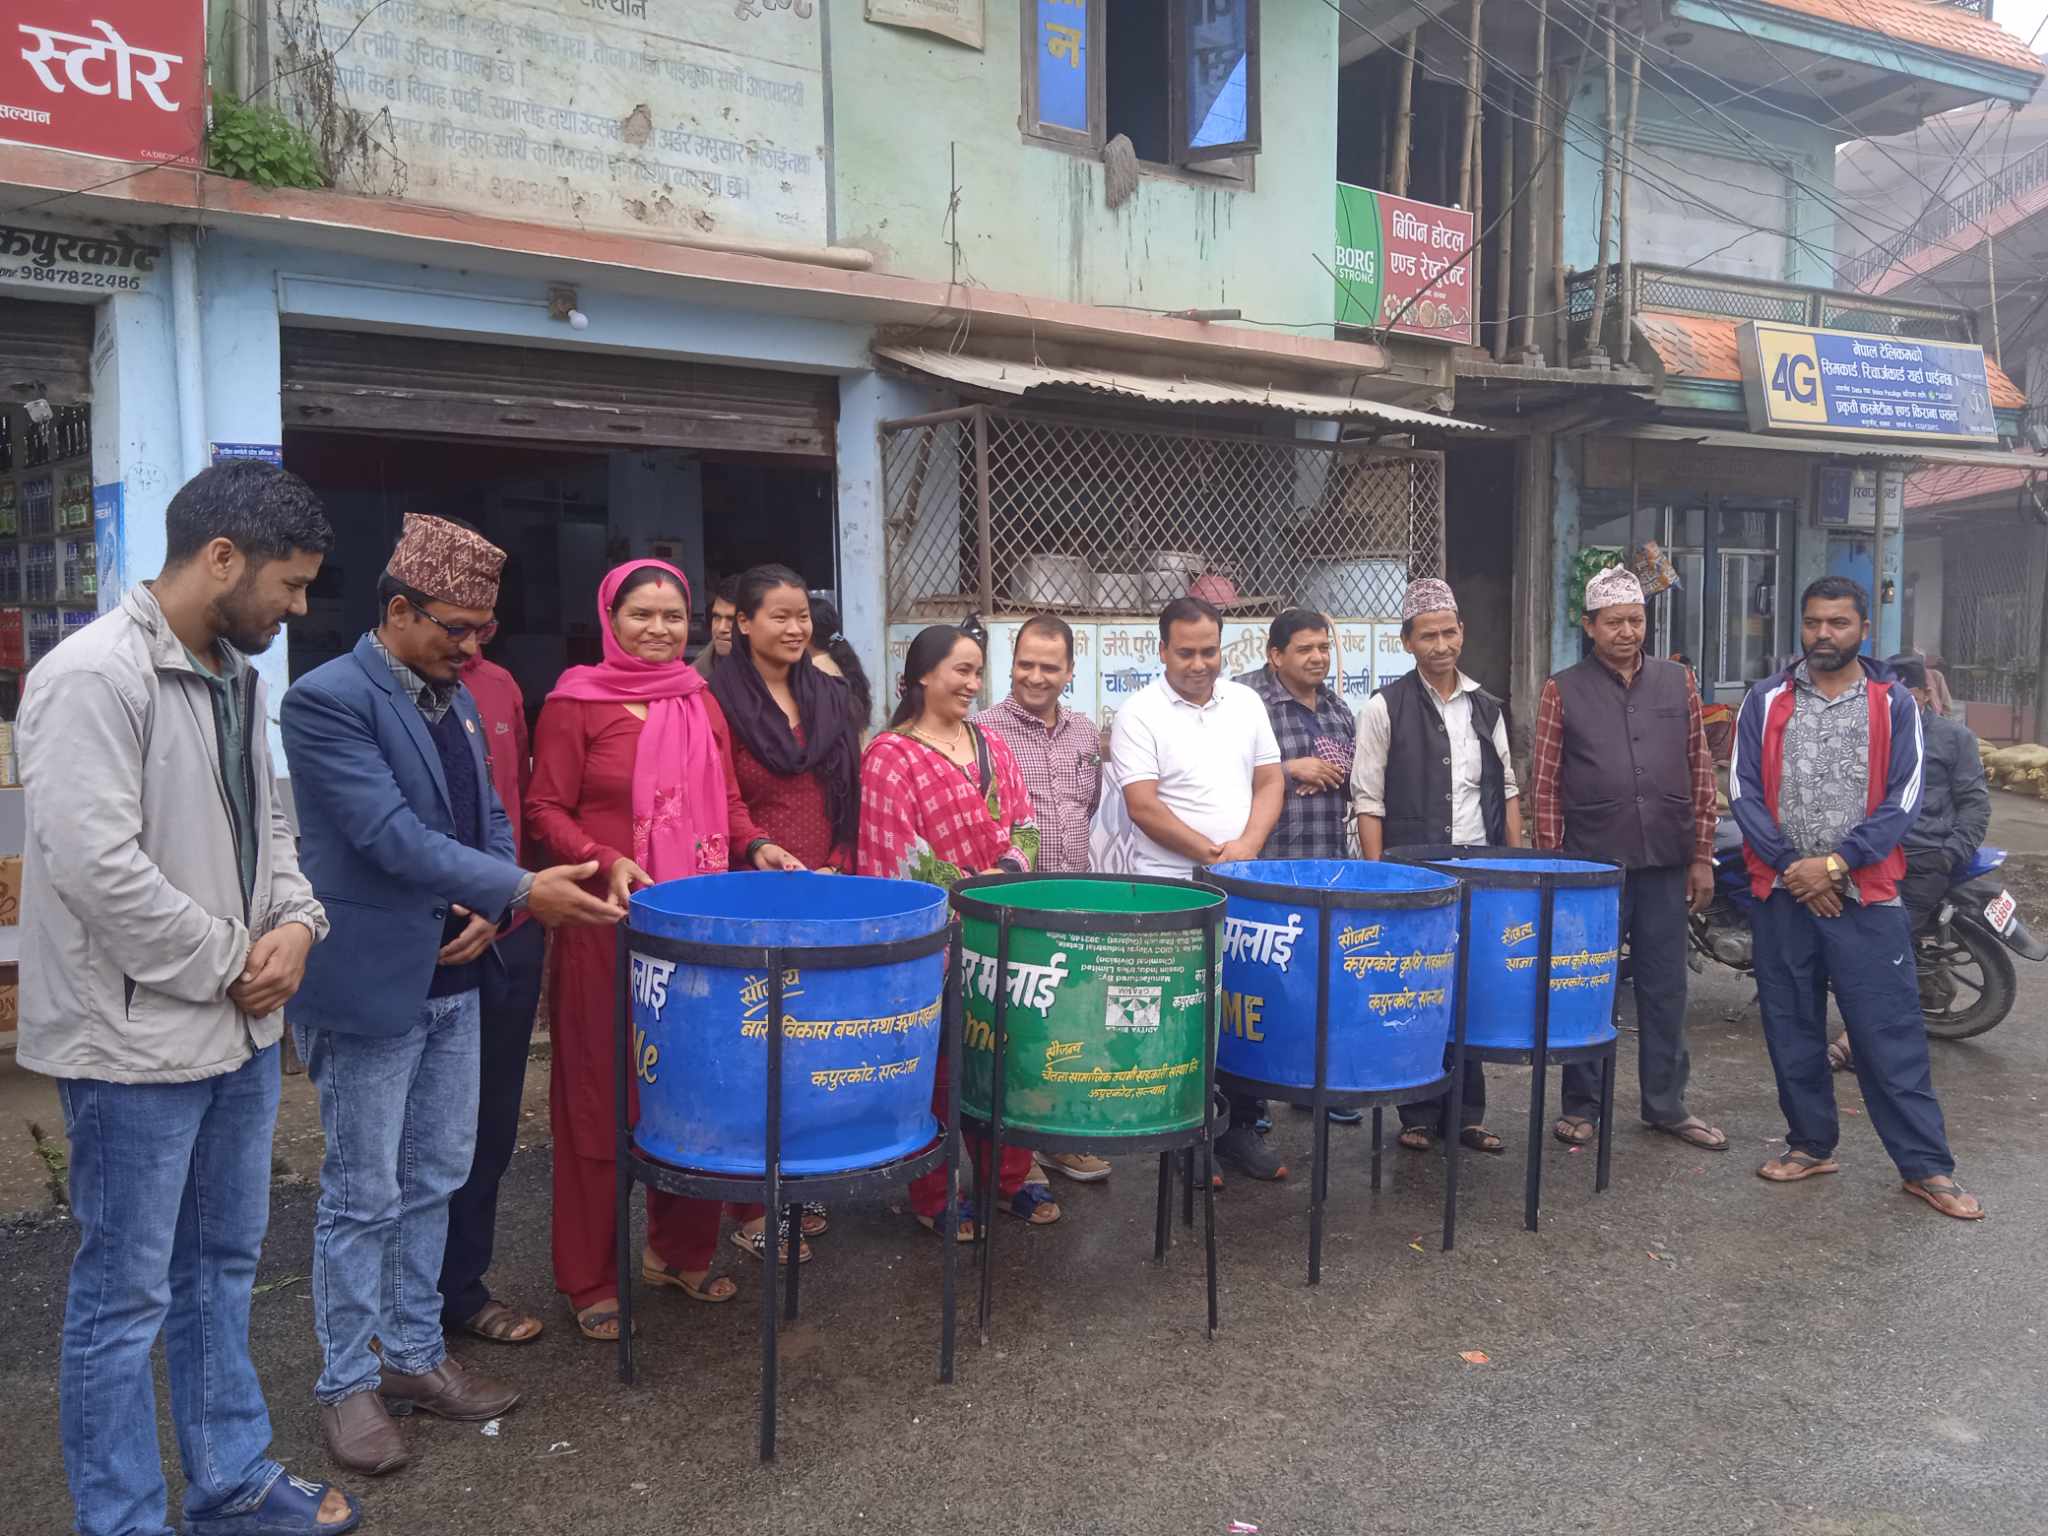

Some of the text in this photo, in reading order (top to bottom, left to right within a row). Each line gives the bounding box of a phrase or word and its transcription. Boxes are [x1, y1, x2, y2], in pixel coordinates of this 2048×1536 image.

[18, 19, 183, 112] स्टोर
[1392, 210, 1465, 252] बिपिन होटल
[1336, 245, 1375, 274] BORG
[1391, 252, 1416, 277] एण्ड
[20, 265, 141, 290] 9847822486
[1339, 268, 1374, 284] STRONG
[1853, 343, 1877, 359] नेपाल
[1772, 353, 1817, 406] 4G
[1081, 964, 1114, 972] Limited
